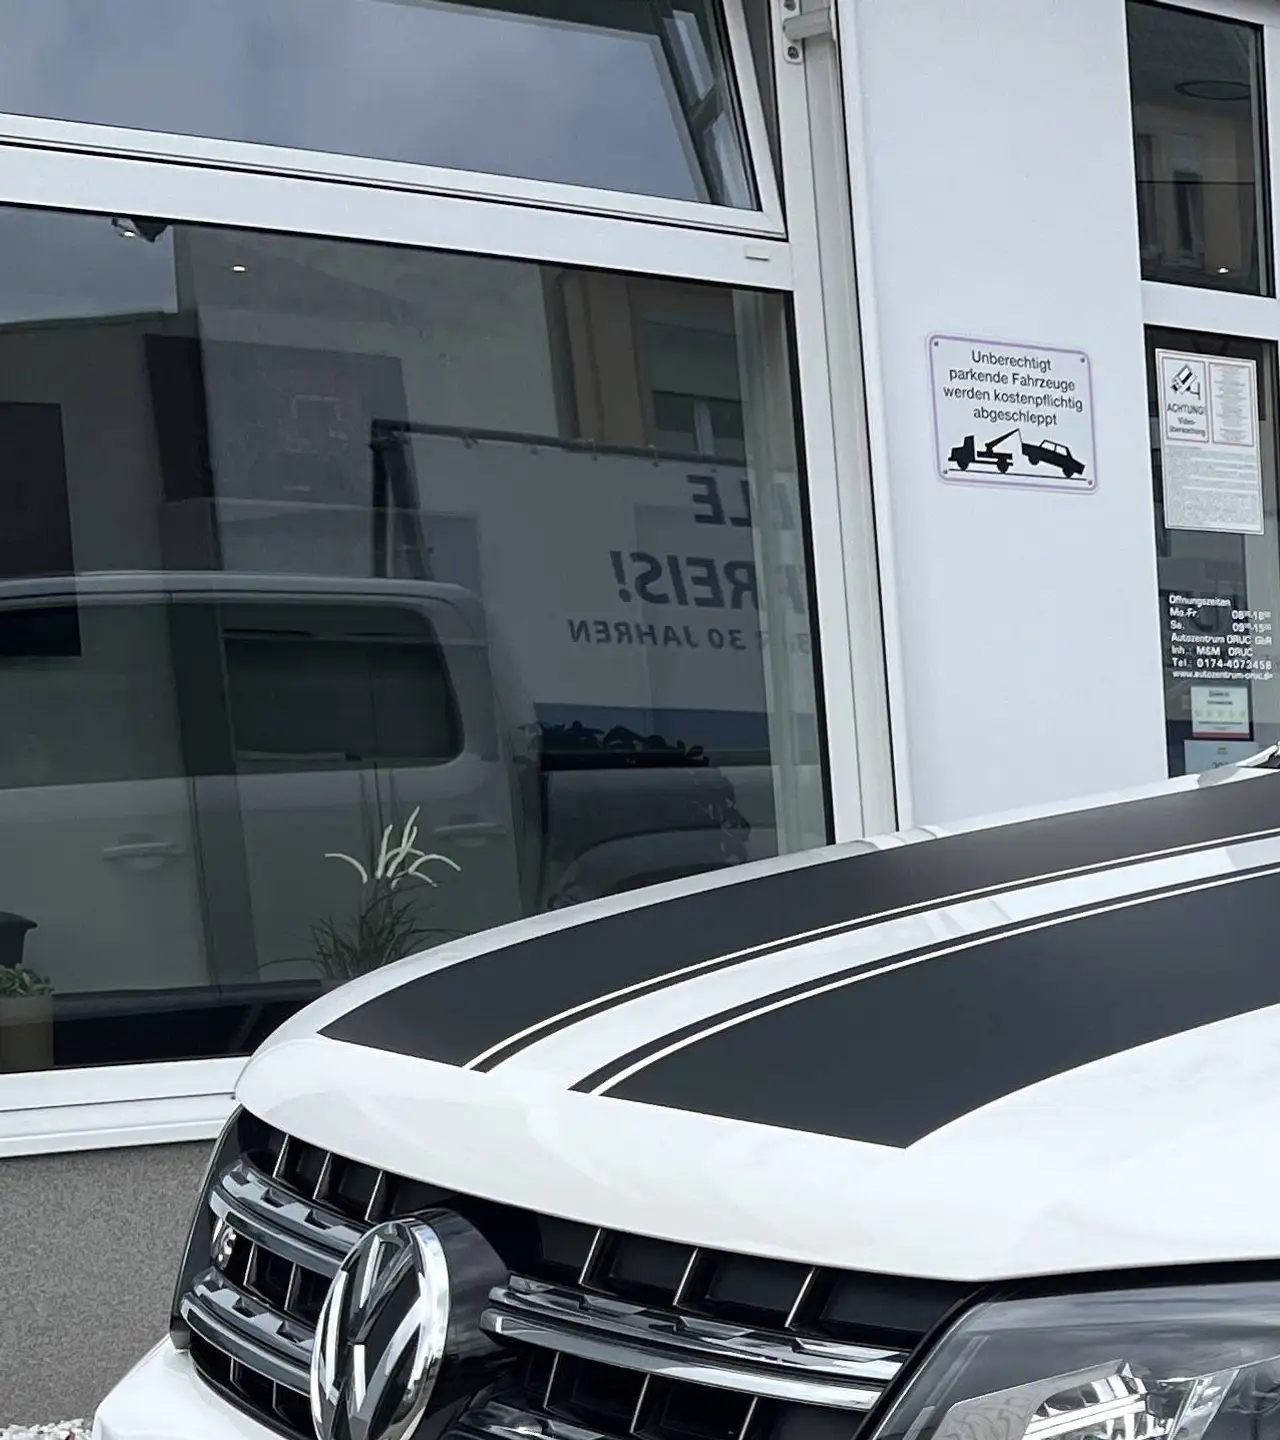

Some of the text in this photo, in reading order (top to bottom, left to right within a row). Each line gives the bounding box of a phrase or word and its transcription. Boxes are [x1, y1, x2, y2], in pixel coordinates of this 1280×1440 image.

[971, 350, 1052, 373] Unberechtigt
[949, 368, 1076, 393] parkende Fahrzeuge
[943, 386, 1083, 413] werden kostenpflichtig
[973, 406, 1058, 427] abgeschleppt
[1171, 632, 1226, 644] Autozentrum
